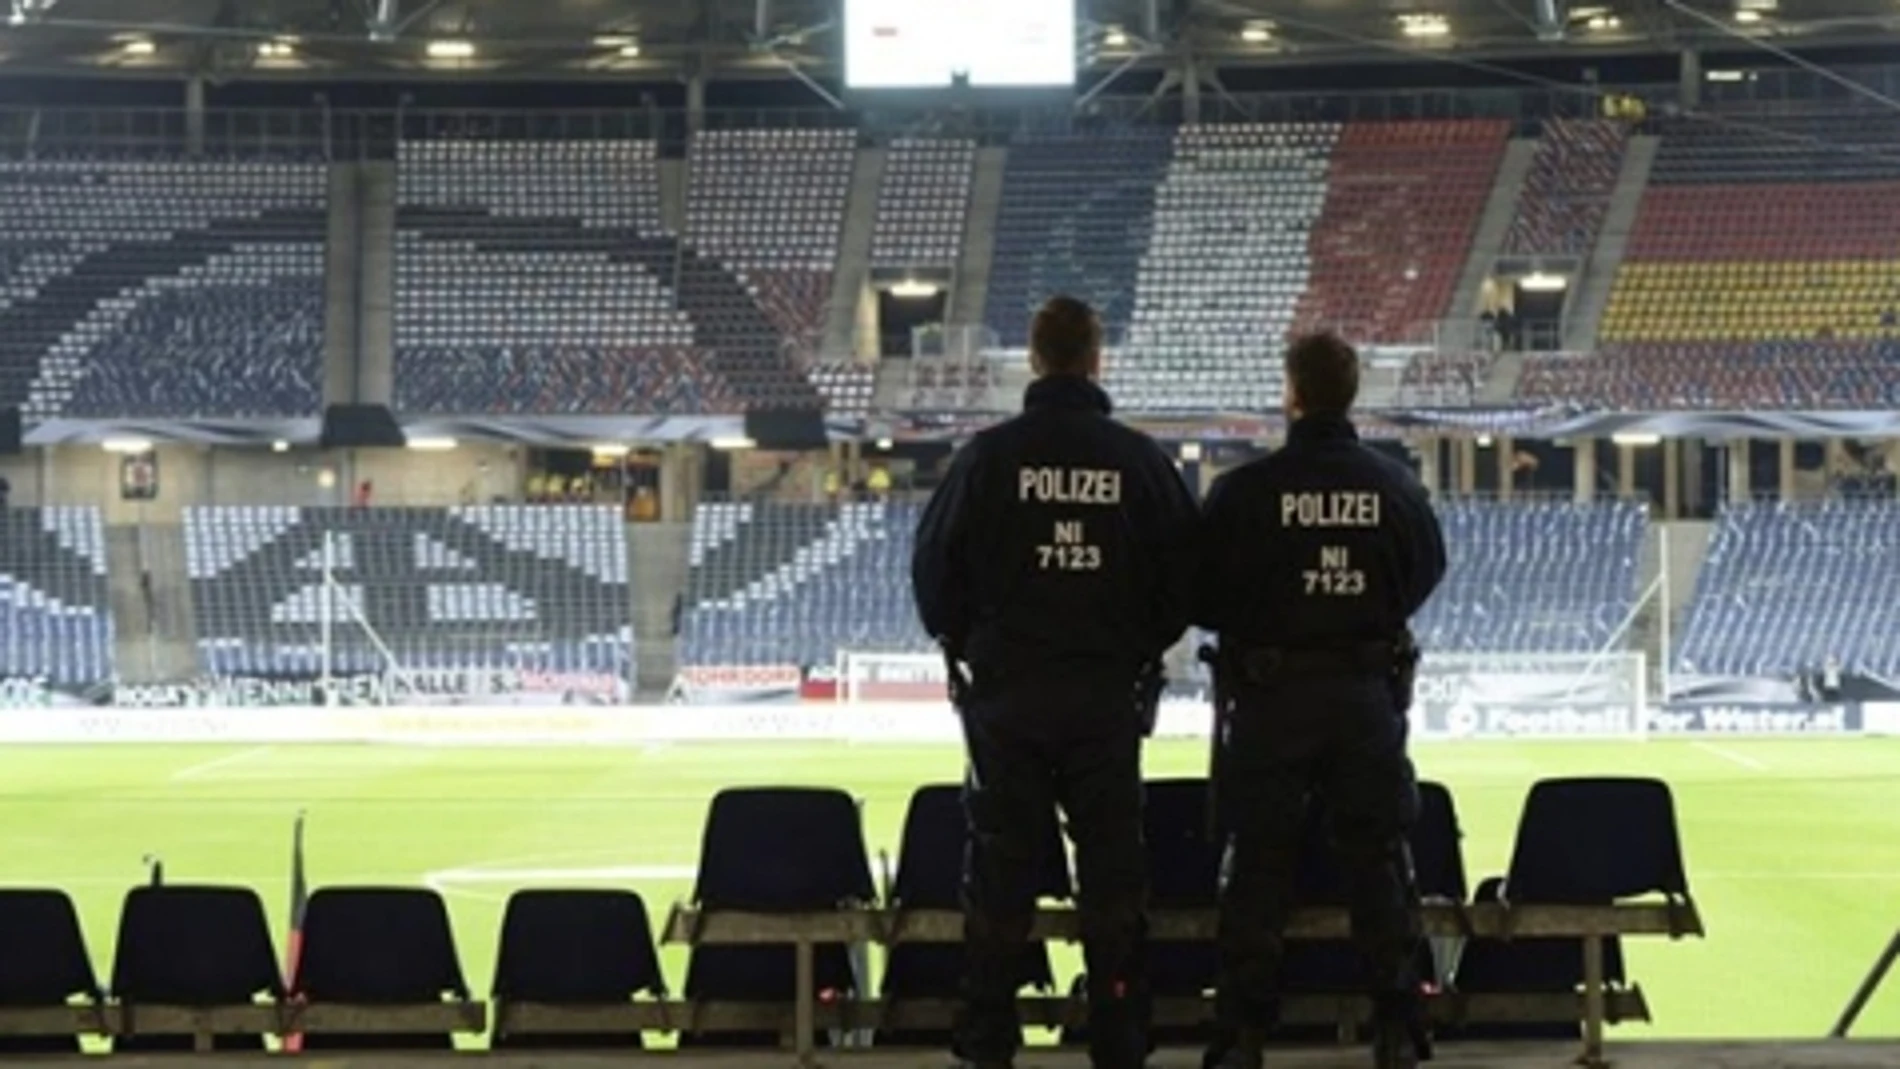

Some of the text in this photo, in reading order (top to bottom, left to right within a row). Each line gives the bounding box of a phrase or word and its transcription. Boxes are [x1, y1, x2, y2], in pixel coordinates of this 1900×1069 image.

[1018, 467, 1121, 504] POLIZEI
[1281, 493, 1380, 526] POLIZEI
[1054, 521, 1083, 544] NI
[1036, 546, 1102, 569] 7123
[1320, 546, 1349, 569] NI
[1302, 570, 1366, 594] 7123
